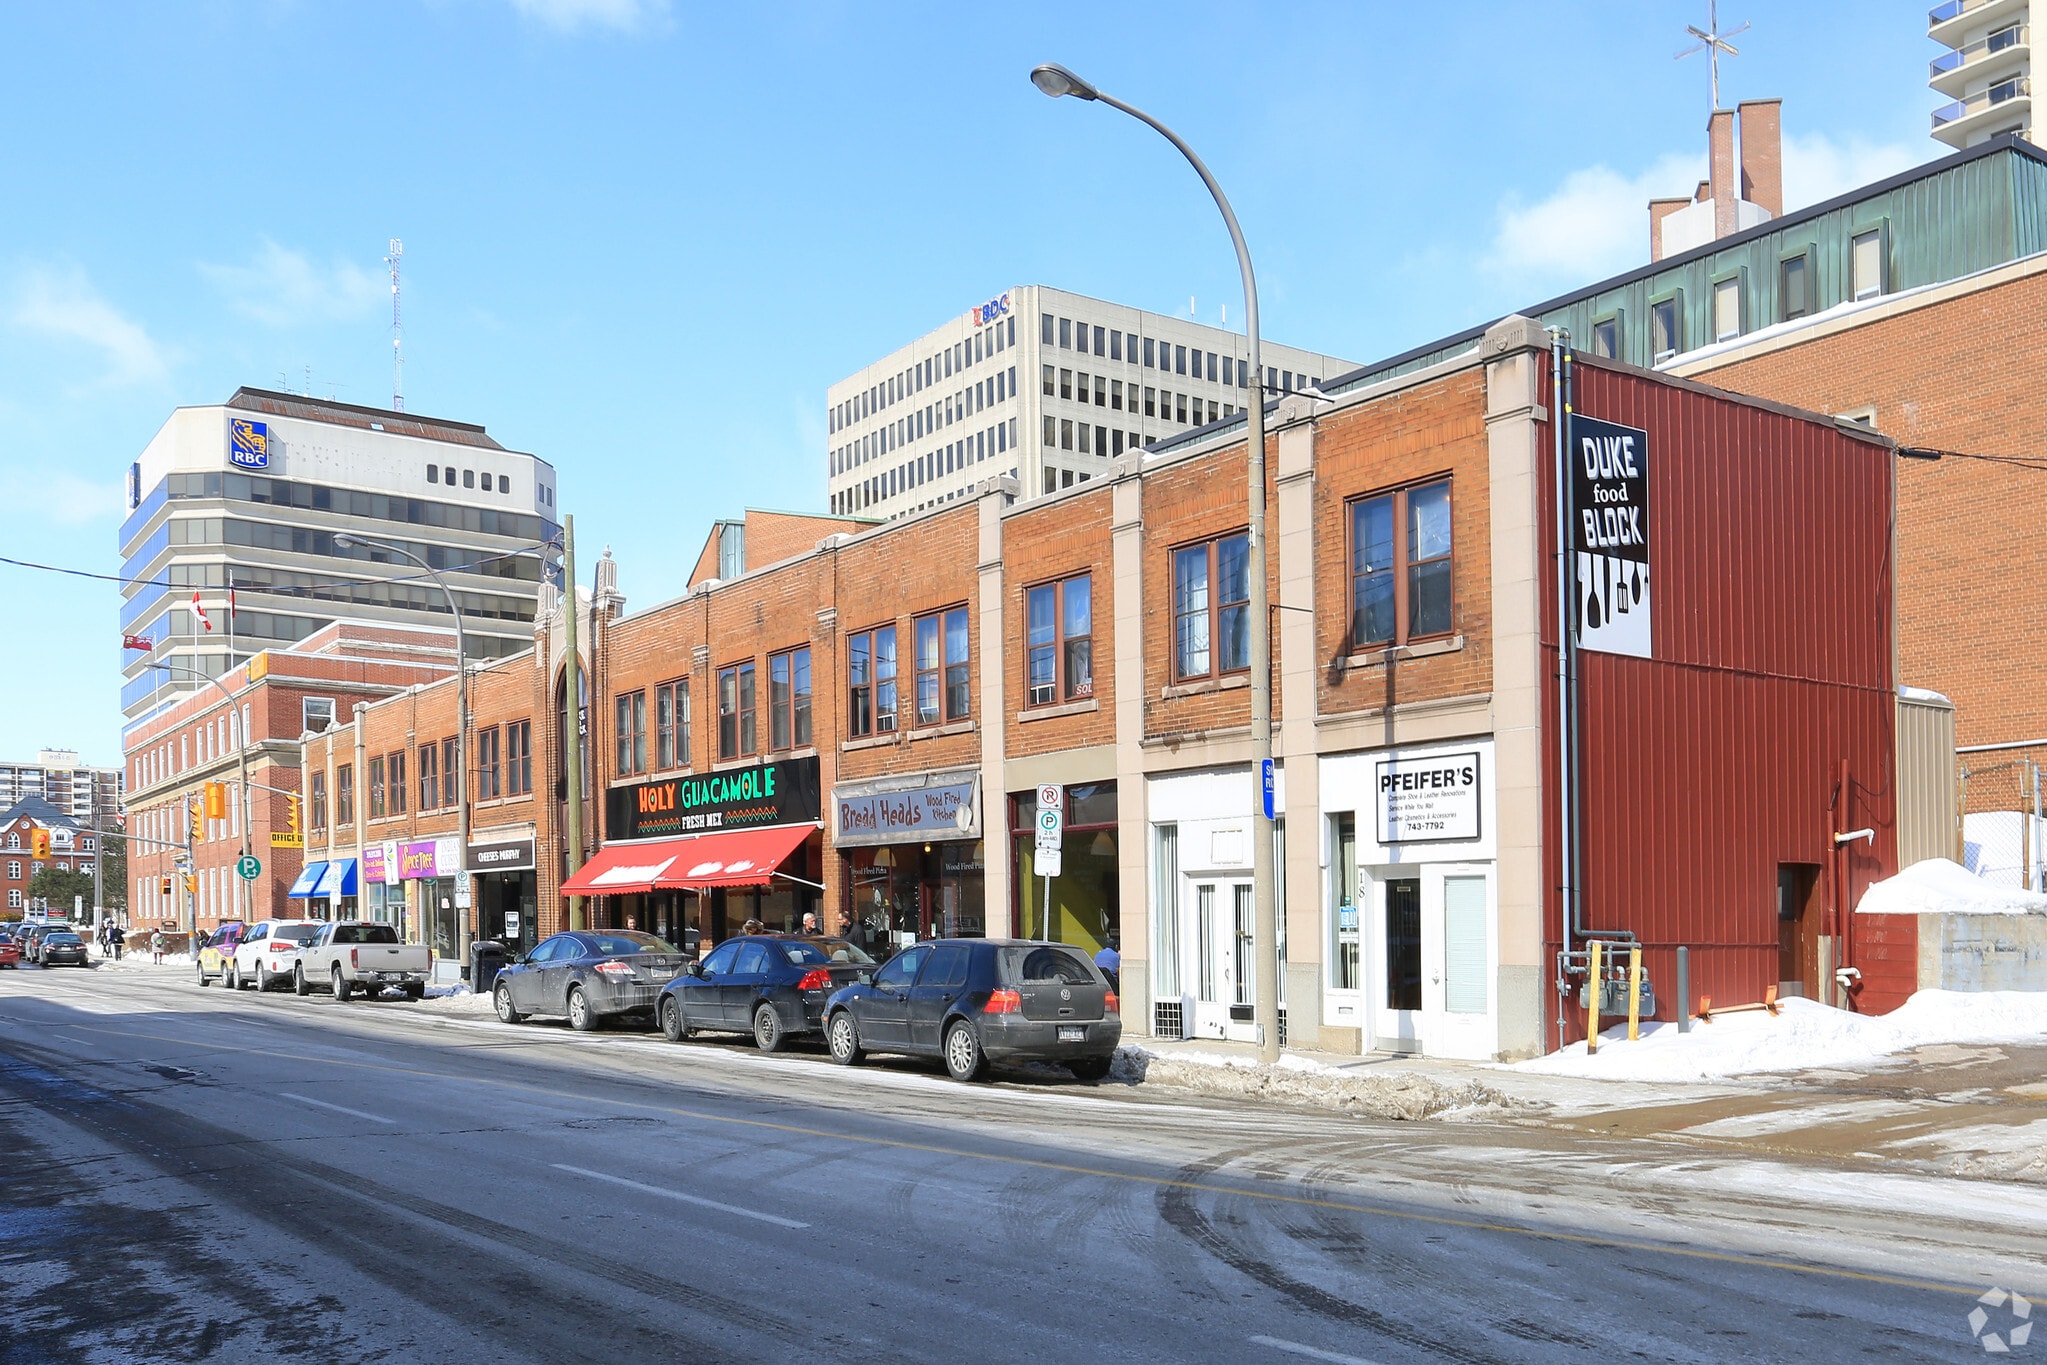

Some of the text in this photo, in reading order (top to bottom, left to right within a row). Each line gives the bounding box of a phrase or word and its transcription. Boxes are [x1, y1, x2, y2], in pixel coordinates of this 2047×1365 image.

[983, 294, 1008, 323] BDC
[234, 451, 265, 465] RBC
[1581, 435, 1639, 481] DUKE
[1593, 482, 1629, 503] food
[1582, 505, 1645, 549] BLOCK
[1076, 684, 1092, 695] SOL
[1381, 767, 1473, 792] PFEIFER'S
[638, 767, 776, 813] HOLY GUACAMOLE
[925, 791, 961, 807] Wood Fired
[682, 812, 723, 830] FRESH MEX
[841, 796, 921, 832] Bread Heads
[1045, 816, 1054, 826] P
[1407, 821, 1445, 831] 743-7792
[272, 834, 295, 842] OFFICE
[244, 858, 256, 874] P
